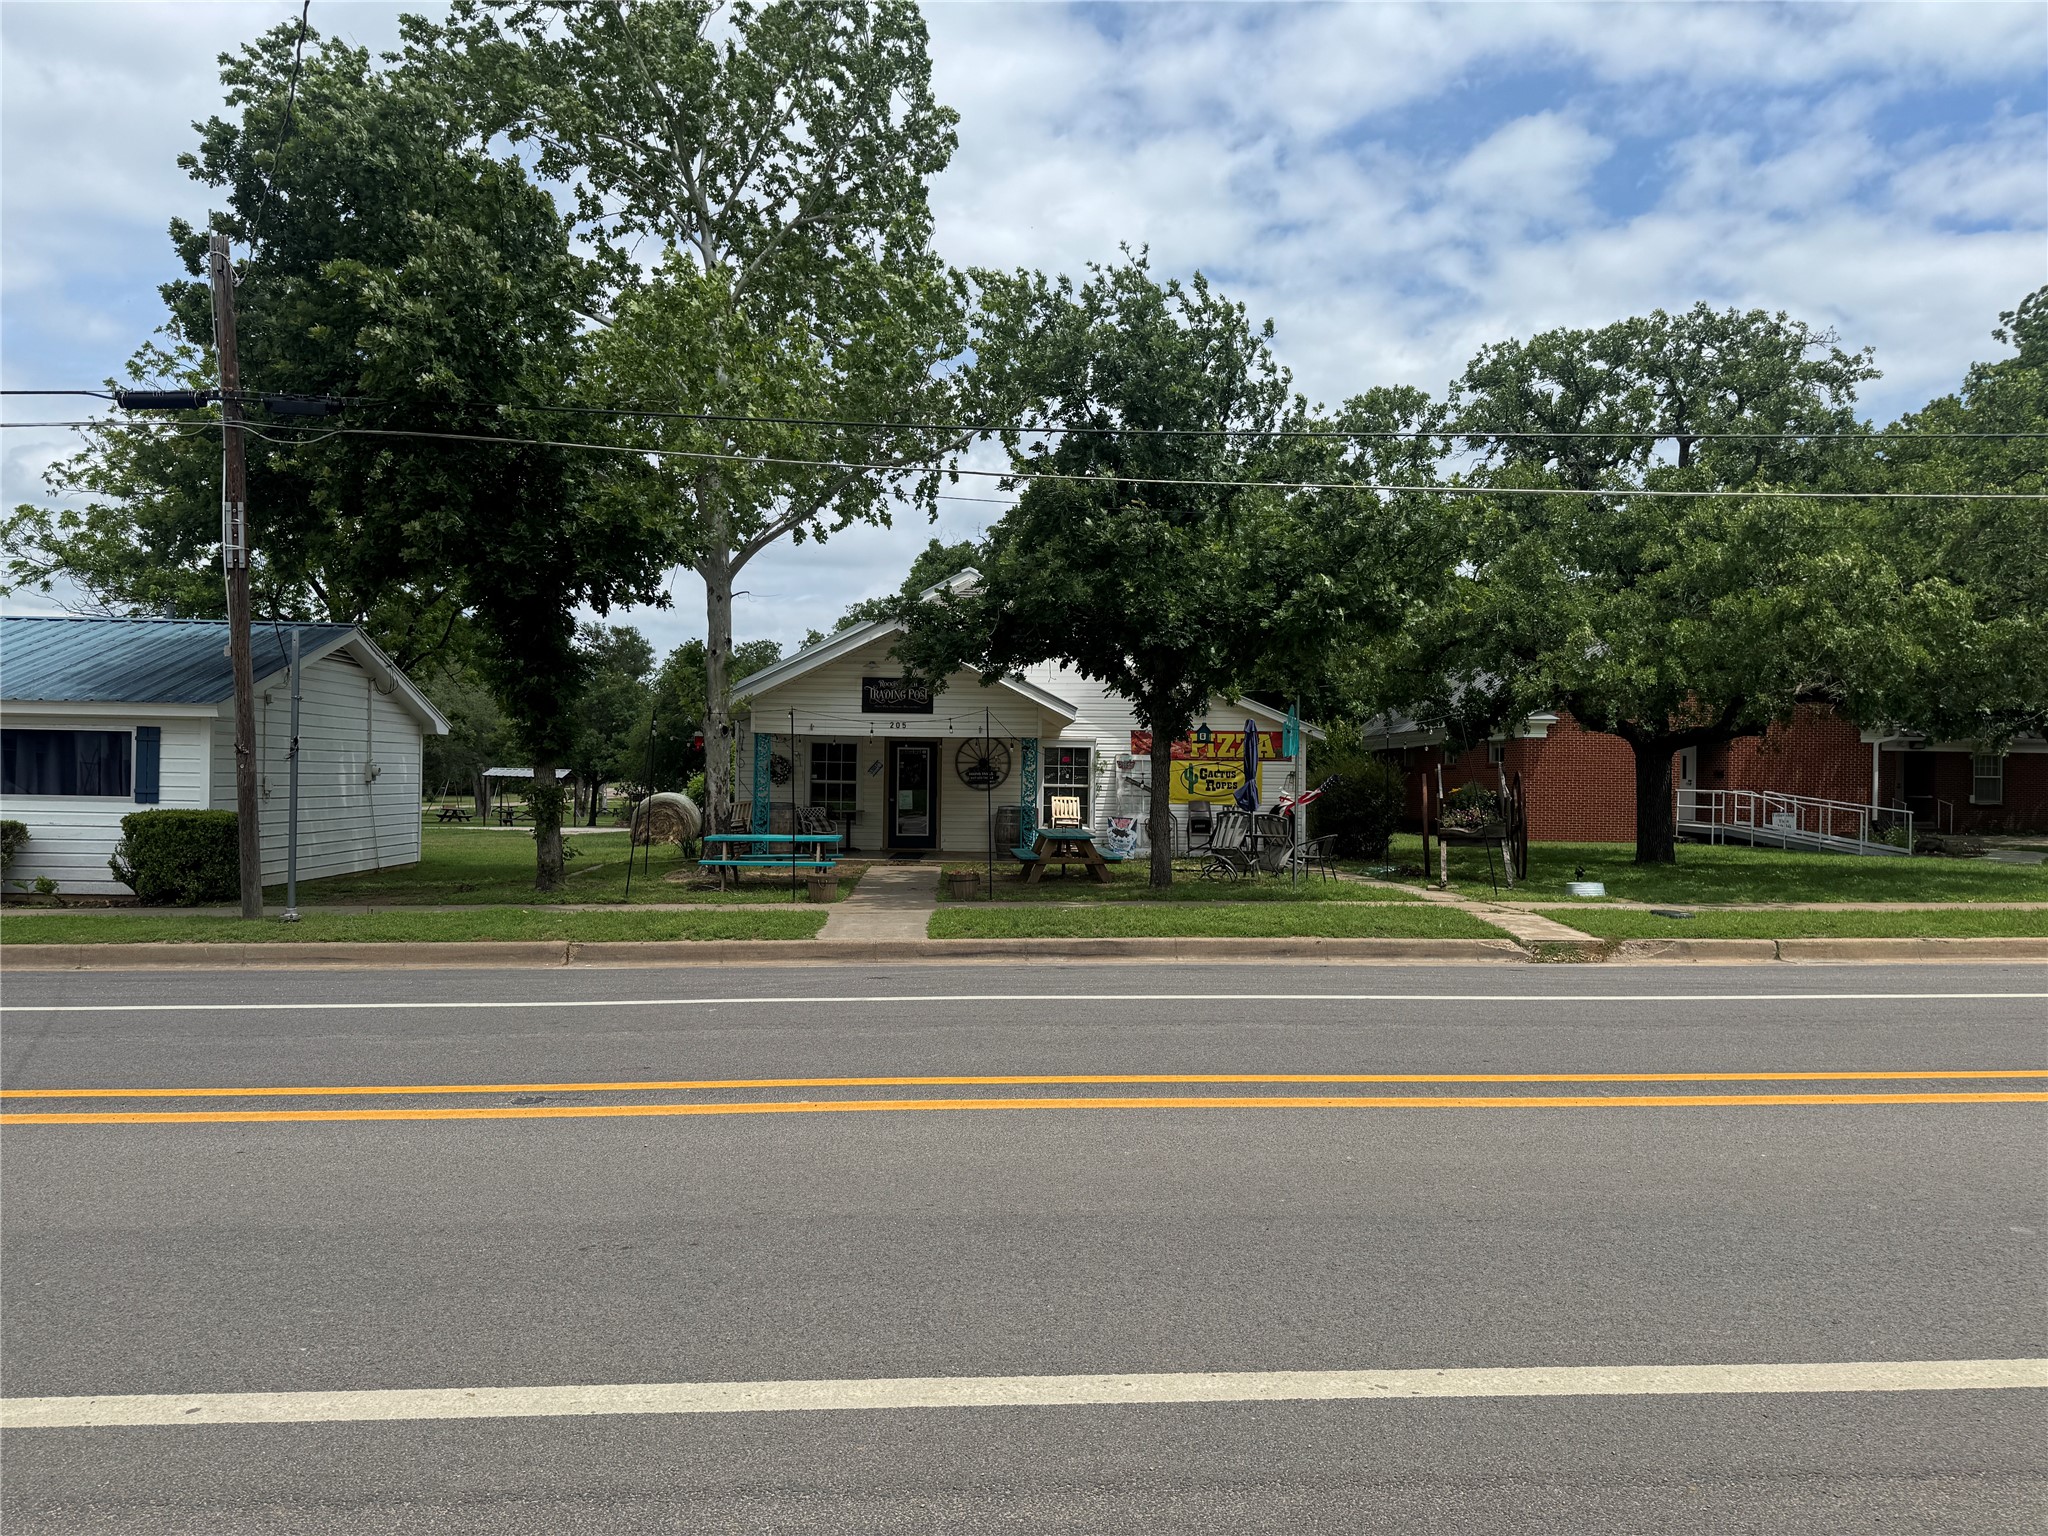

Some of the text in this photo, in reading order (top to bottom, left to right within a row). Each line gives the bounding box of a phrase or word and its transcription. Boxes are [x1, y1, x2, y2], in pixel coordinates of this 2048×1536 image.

[864, 686, 929, 704] TRADING POST
[1200, 768, 1236, 780] CACTUS
[1205, 780, 1238, 791] ROPES
